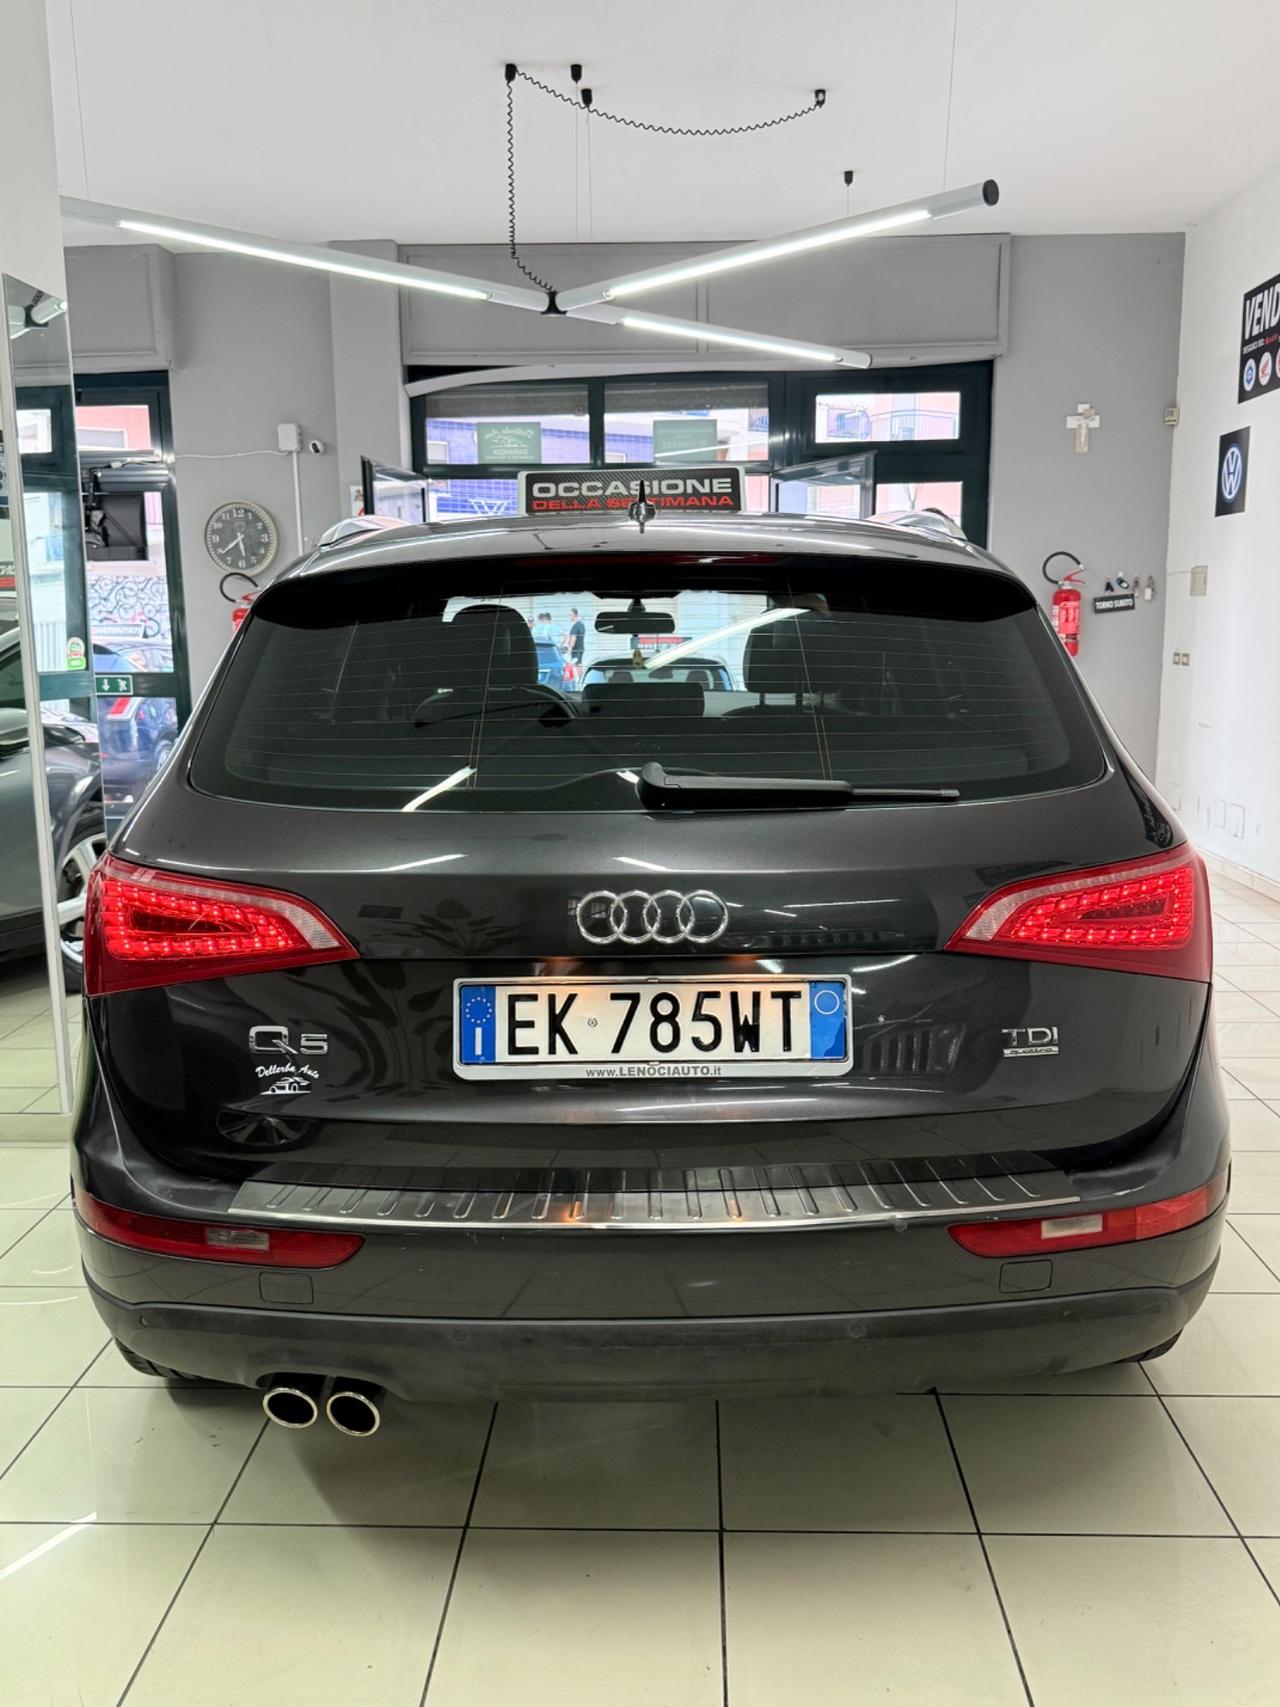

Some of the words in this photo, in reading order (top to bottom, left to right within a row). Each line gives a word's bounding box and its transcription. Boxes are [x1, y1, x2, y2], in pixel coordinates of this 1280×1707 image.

[532, 478, 732, 498] OCCASIONE
[531, 496, 601, 510] DELLA
[606, 495, 734, 509] SEIMANA
[508, 992, 578, 1055] EK
[609, 990, 802, 1054] 785WT
[248, 1025, 328, 1055] Q5
[1001, 1026, 1059, 1046] TDI
[585, 1065, 722, 1077] www.LENOCIAUTO.it
